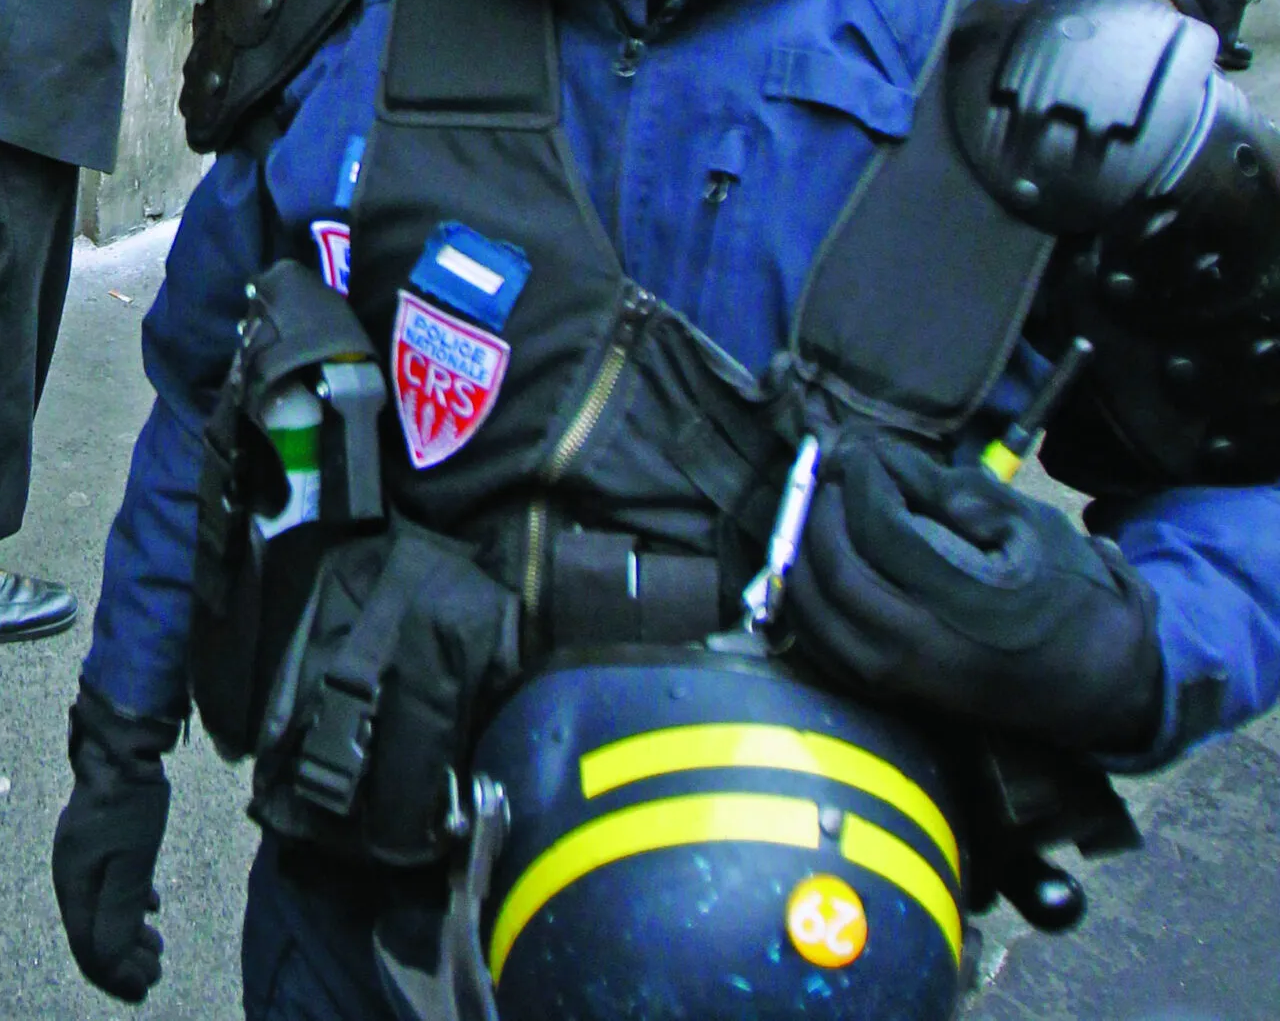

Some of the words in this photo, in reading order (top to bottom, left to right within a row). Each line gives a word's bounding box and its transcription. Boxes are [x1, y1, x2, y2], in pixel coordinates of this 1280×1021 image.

[405, 326, 488, 383] NATIONALE
[413, 313, 487, 366] POLICE
[403, 349, 476, 419] CRS
